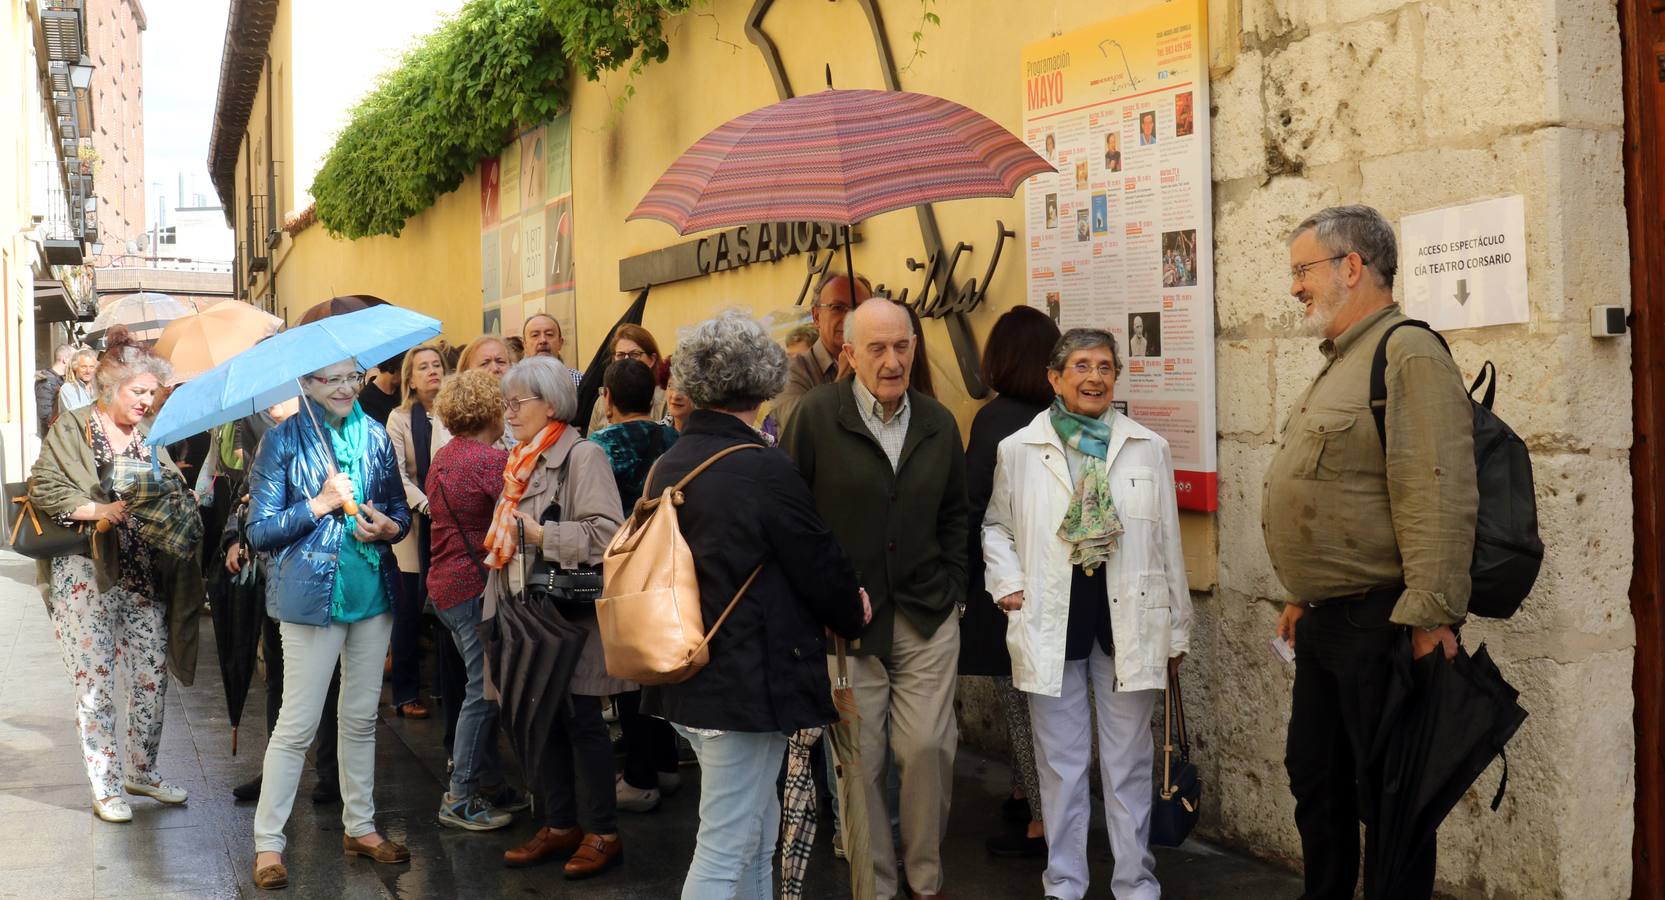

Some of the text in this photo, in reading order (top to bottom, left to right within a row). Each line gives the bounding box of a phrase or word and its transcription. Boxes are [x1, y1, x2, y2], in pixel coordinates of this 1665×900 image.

[1027, 49, 1070, 78] Programación
[1027, 70, 1064, 111] MAYO
[1418, 234, 1505, 257] ACCESO ESPECTÁCULO
[1414, 252, 1512, 277] CÍA TEATRO CORSARIO
